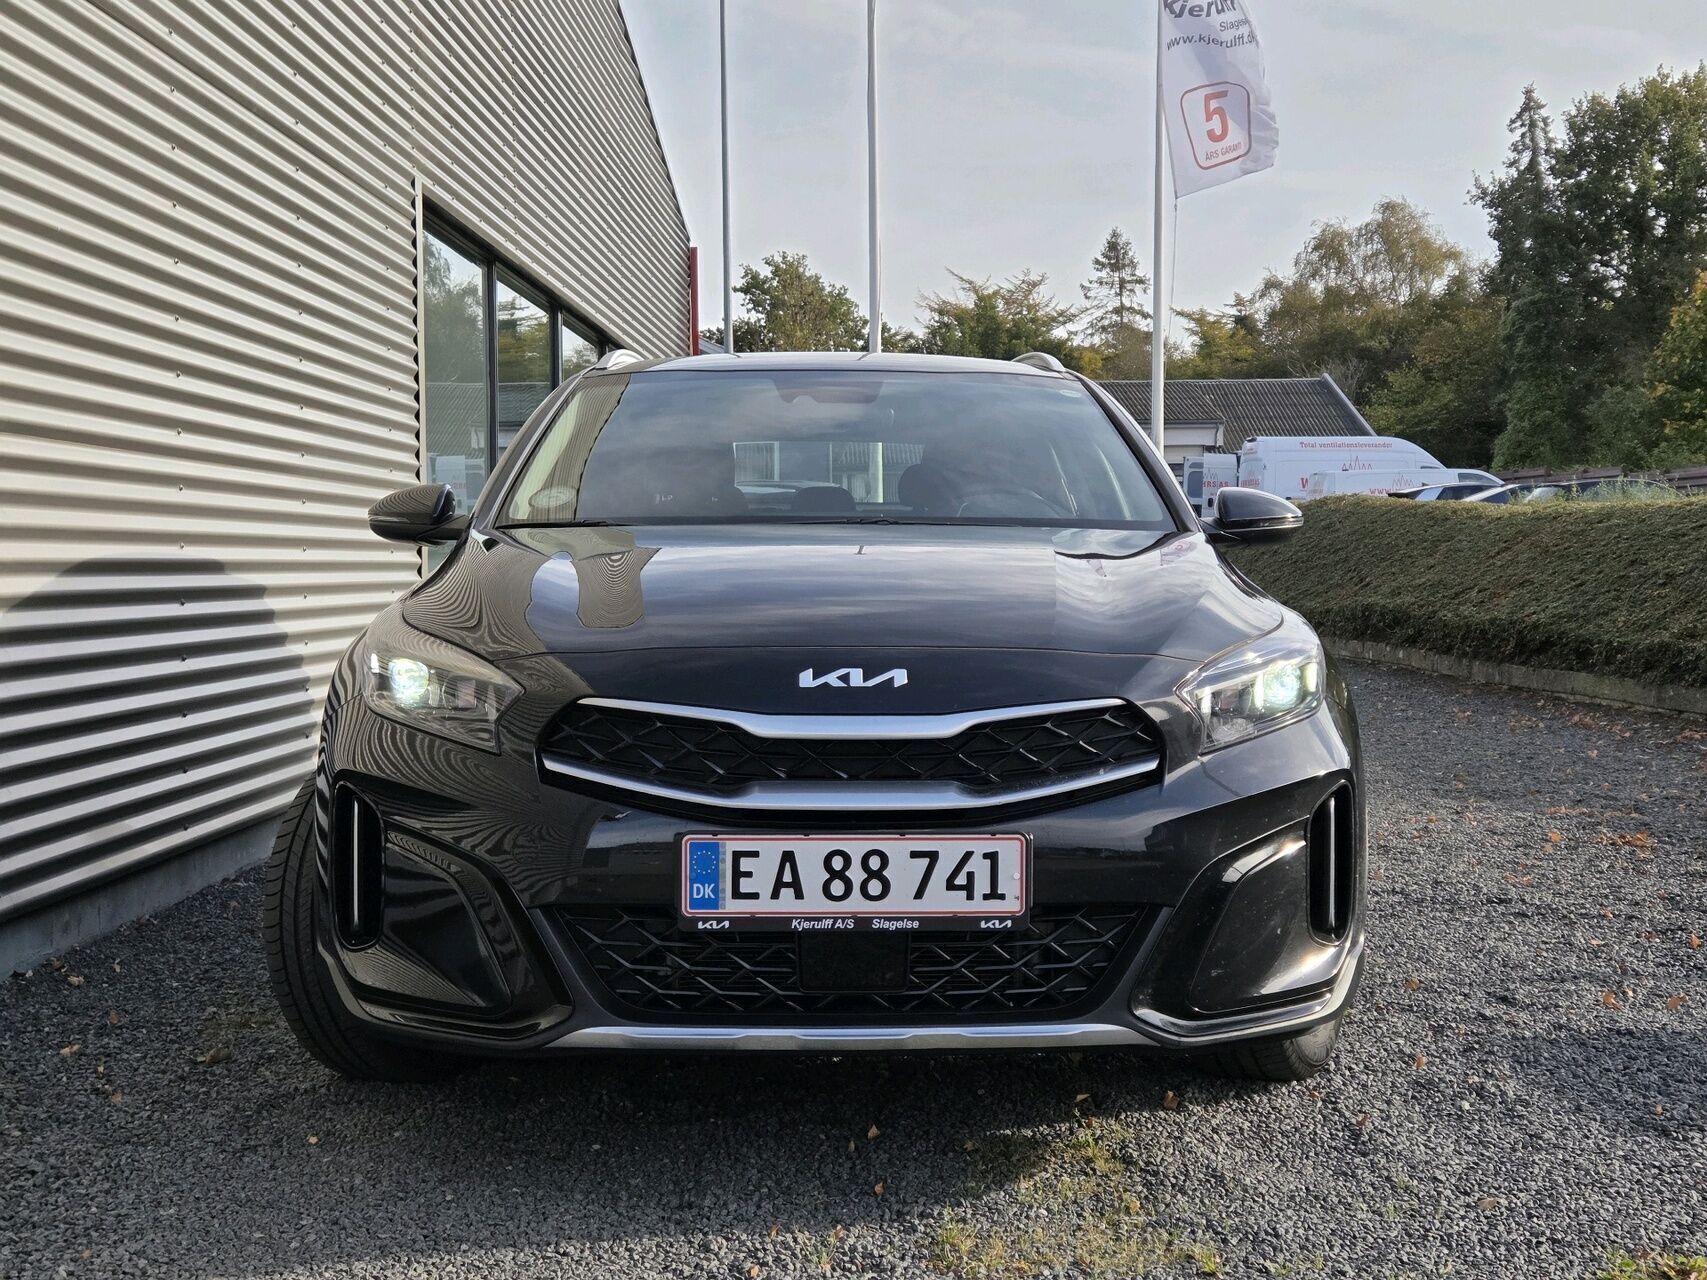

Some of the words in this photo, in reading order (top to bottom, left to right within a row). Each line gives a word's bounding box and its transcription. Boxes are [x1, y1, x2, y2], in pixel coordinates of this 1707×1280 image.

[1204, 90, 1229, 143] 5
[799, 668, 908, 688] KIA
[731, 850, 805, 900] EA
[822, 849, 891, 902] 88
[909, 850, 1006, 901] 741
[692, 884, 716, 899] DK
[697, 920, 730, 929] KIA
[791, 918, 833, 930] Kjerulff
[834, 918, 855, 930] A/S
[871, 918, 920, 930] Slagelse
[980, 920, 1012, 929] KIA
